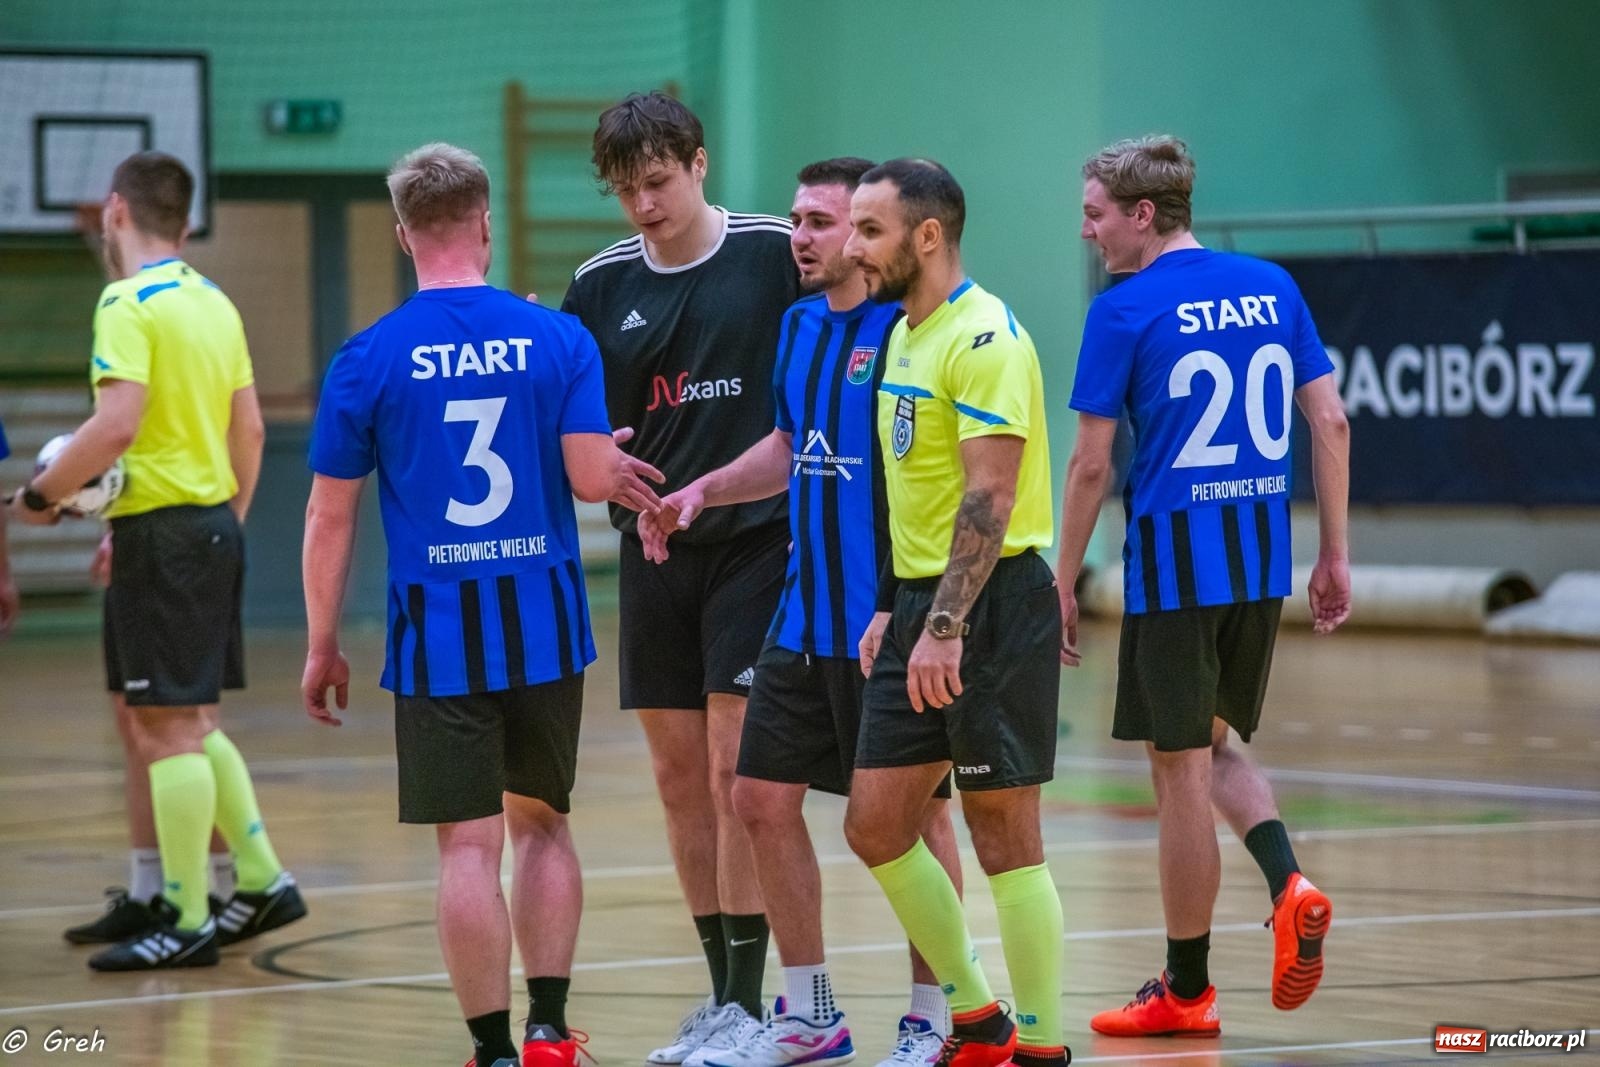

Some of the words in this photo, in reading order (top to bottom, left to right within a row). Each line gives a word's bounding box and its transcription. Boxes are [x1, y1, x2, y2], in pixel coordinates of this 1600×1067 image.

[620, 319, 647, 331] adidas
[1176, 295, 1280, 334] START
[411, 338, 533, 380] START
[646, 371, 742, 412] Nexans
[1168, 343, 1295, 469] 20
[443, 396, 514, 527] 3
[1191, 477, 1255, 502] PIETROWICE
[1256, 475, 1287, 495] WIELKIE
[428, 539, 499, 564] PIETROWICE
[500, 535, 548, 558] WIELKIE
